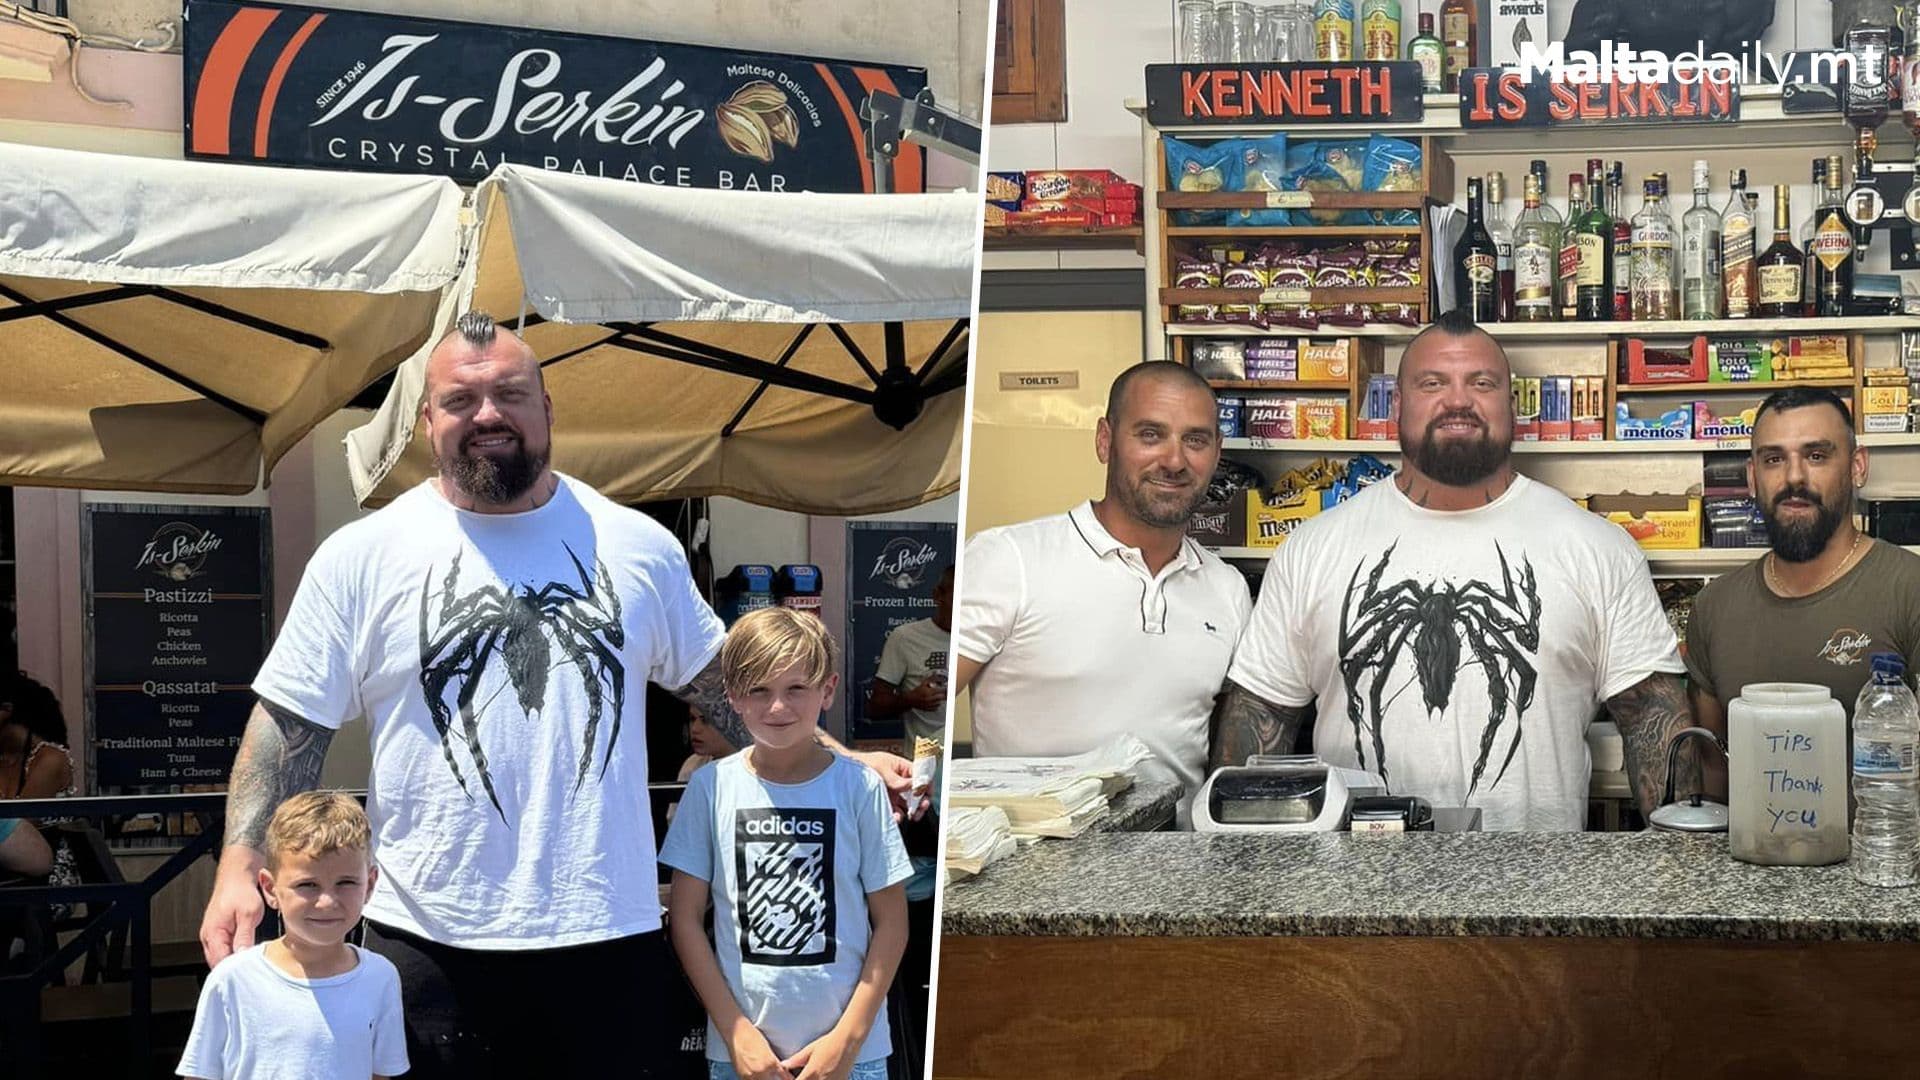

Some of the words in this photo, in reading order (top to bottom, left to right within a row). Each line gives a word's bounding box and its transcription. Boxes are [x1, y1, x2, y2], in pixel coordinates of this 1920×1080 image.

[1499, 1, 1544, 15] awards
[315, 78, 346, 108] SINCE
[344, 59, 367, 84] 1946
[726, 63, 775, 79] Maltese
[777, 72, 822, 127] Delicacies
[1181, 66, 1392, 118] KENNETH
[1469, 72, 1528, 121] IS
[718, 170, 787, 193] BAR
[1816, 238, 1850, 249] AVERNA
[1211, 351, 1242, 360] HALLS
[1304, 350, 1347, 361] HALLS
[1019, 377, 1059, 385] TOILETS
[1251, 409, 1294, 421] HALLS
[1306, 408, 1334, 416] HALLS
[1623, 427, 1685, 439] mentos
[1703, 424, 1753, 436] mento
[143, 587, 214, 604] Pastizzi
[864, 596, 905, 608] Frozen
[908, 596, 938, 608] Item
[160, 612, 199, 623] Ricotta
[167, 627, 192, 637] Peas
[157, 640, 201, 651] Chicken
[151, 655, 207, 666] Anchovies
[142, 680, 218, 695] Qassatat
[161, 702, 200, 713] Ricotta
[168, 717, 193, 728] Peas
[101, 736, 172, 749] Traditional
[176, 736, 225, 748] Maltese
[167, 753, 196, 763] Tuna
[140, 768, 166, 778] Ham
[170, 768, 180, 778] &
[183, 767, 222, 777] Cheese
[1763, 769, 1824, 796] Thank
[745, 815, 825, 836] adidas
[1368, 822, 1385, 831] BOV
